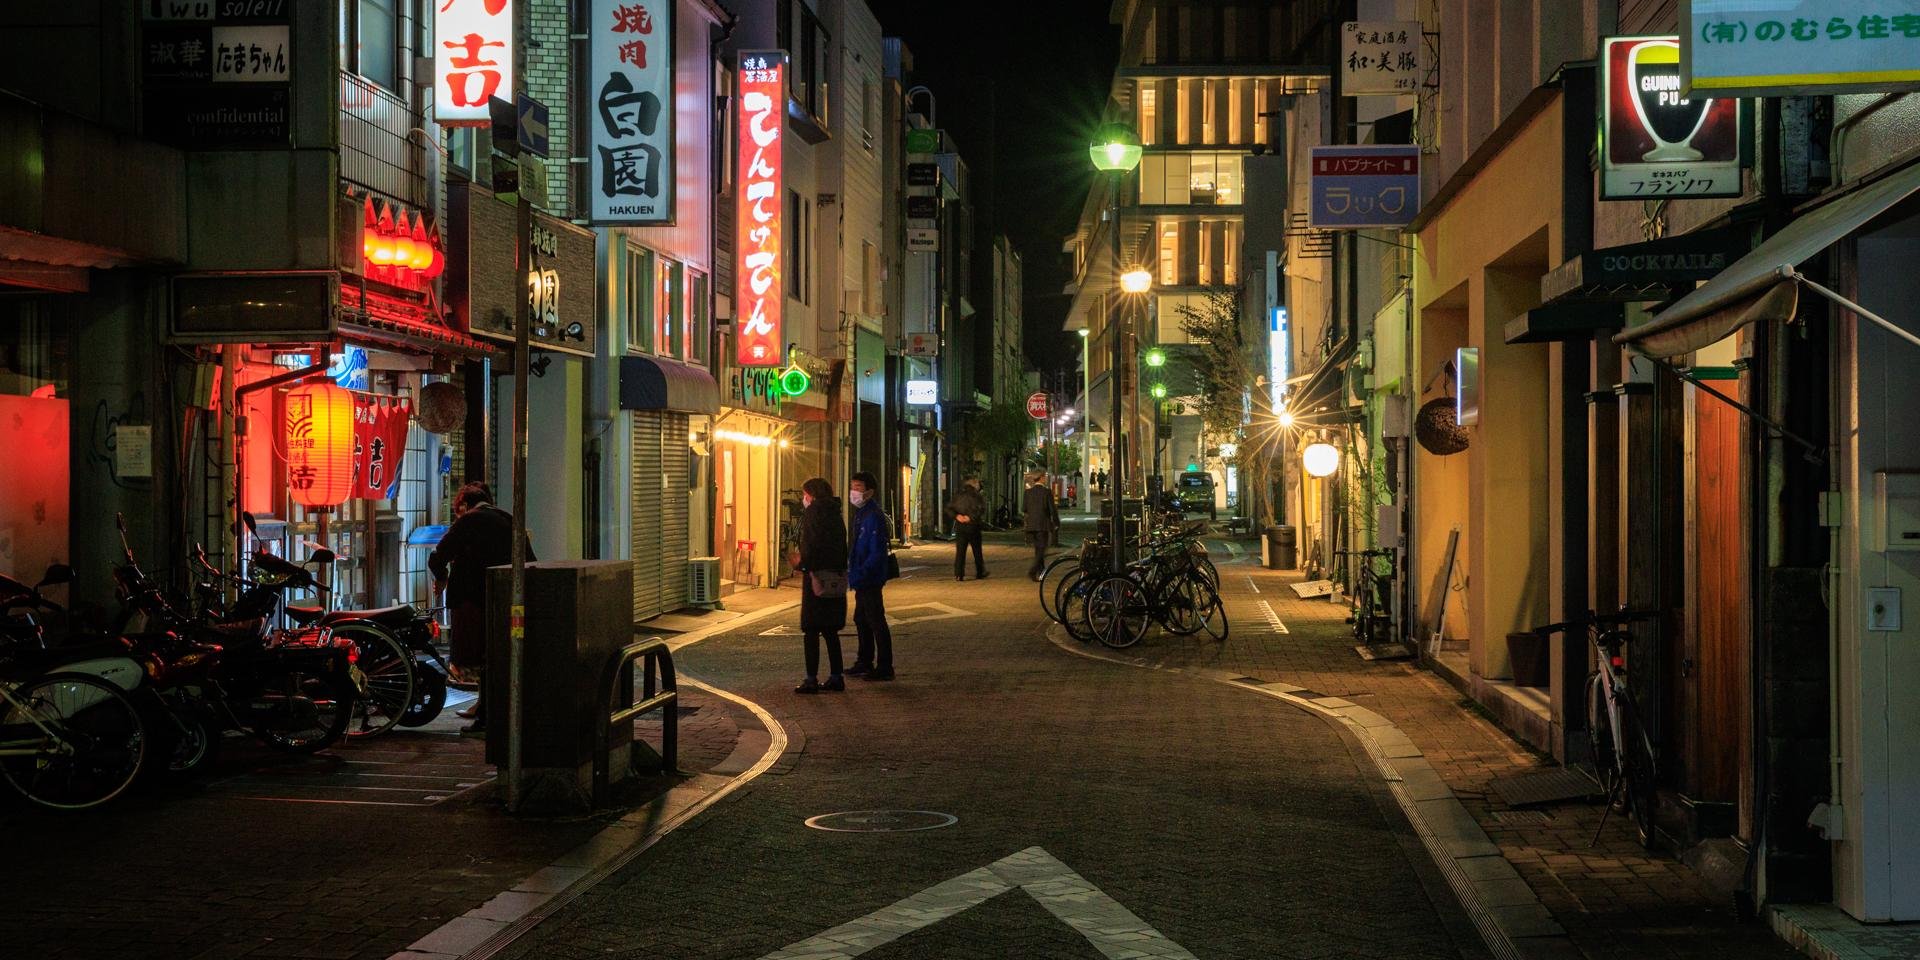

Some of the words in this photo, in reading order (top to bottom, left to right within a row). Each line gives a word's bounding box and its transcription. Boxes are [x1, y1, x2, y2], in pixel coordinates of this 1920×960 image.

[611, 4, 653, 70] 焼肉
[1347, 24, 1359, 33] 2F
[149, 39, 206, 66] 淑華
[216, 43, 286, 74] たまちゃん
[1641, 75, 1680, 92] GUINN
[187, 107, 285, 124] confidential
[597, 71, 661, 199] 白園
[1334, 159, 1396, 172] パブナイト
[1629, 179, 1714, 194] フランソワ
[609, 205, 655, 215] HAKUEN
[1326, 187, 1405, 215] ラック
[1602, 253, 1727, 272] COCKTAILS
